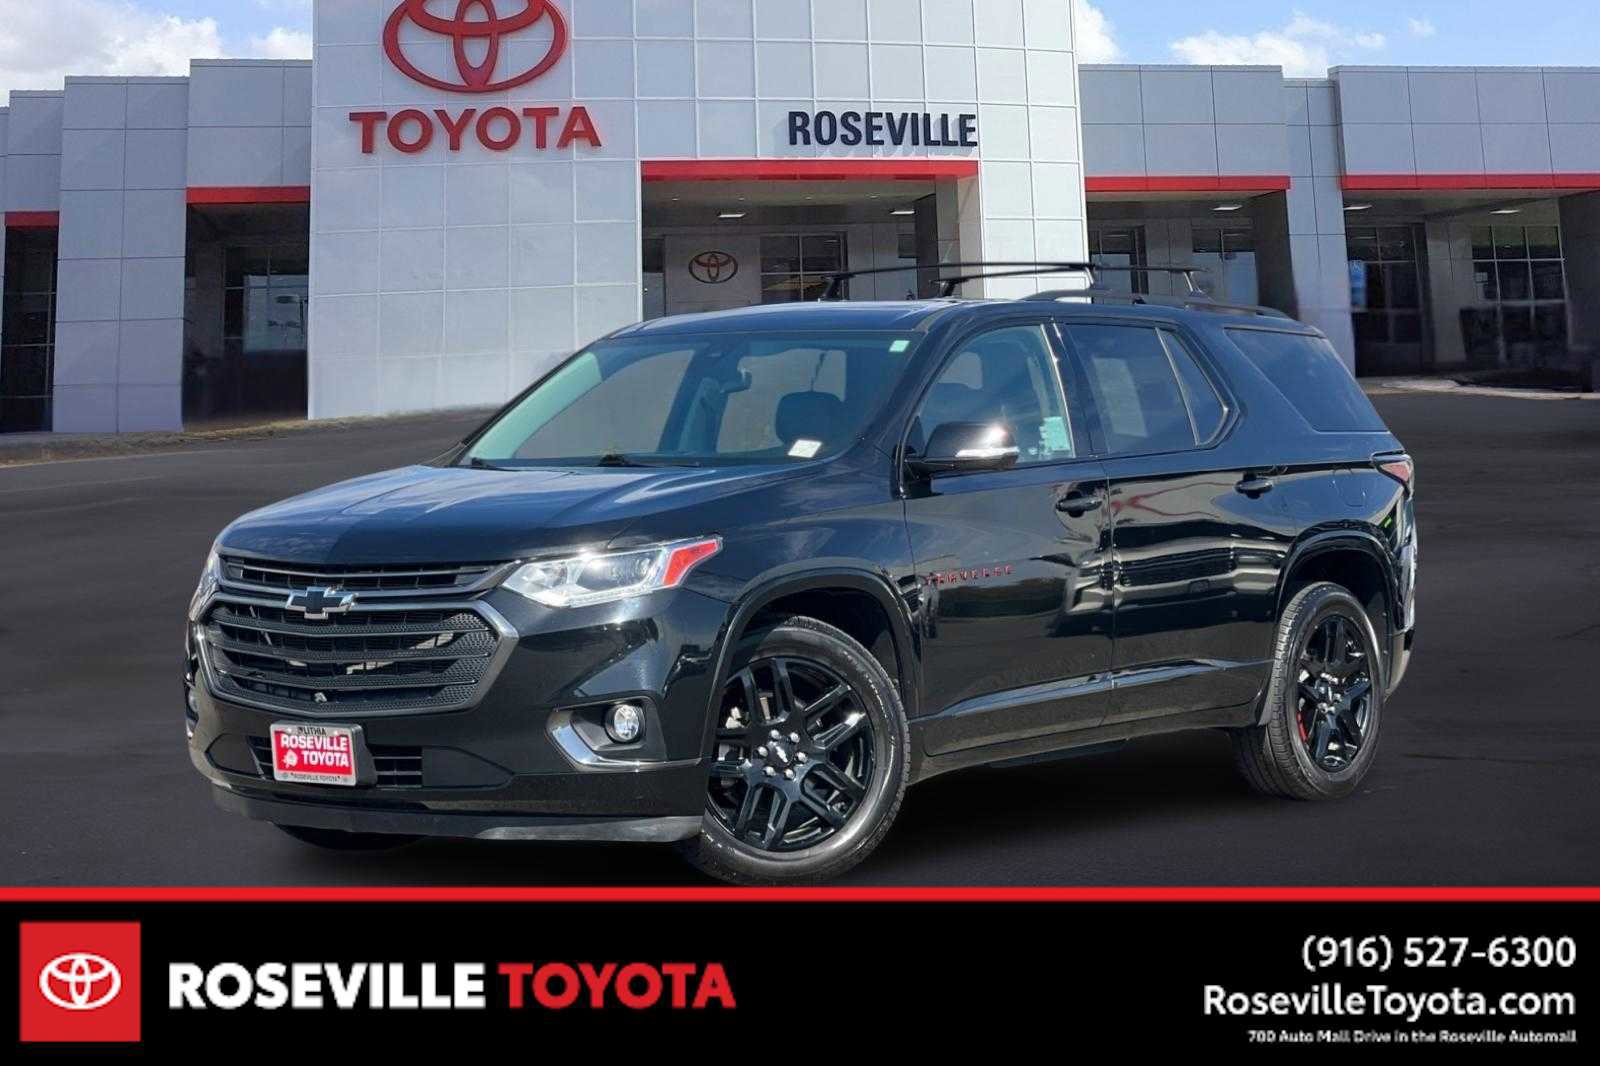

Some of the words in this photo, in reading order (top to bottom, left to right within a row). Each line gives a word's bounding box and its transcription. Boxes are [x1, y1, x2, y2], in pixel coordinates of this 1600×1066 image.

[349, 106, 602, 153] TOYOTA
[789, 110, 978, 147] ROSEVILLE
[281, 733, 348, 752] ROSEVILLE
[301, 750, 350, 768] TOYOTA
